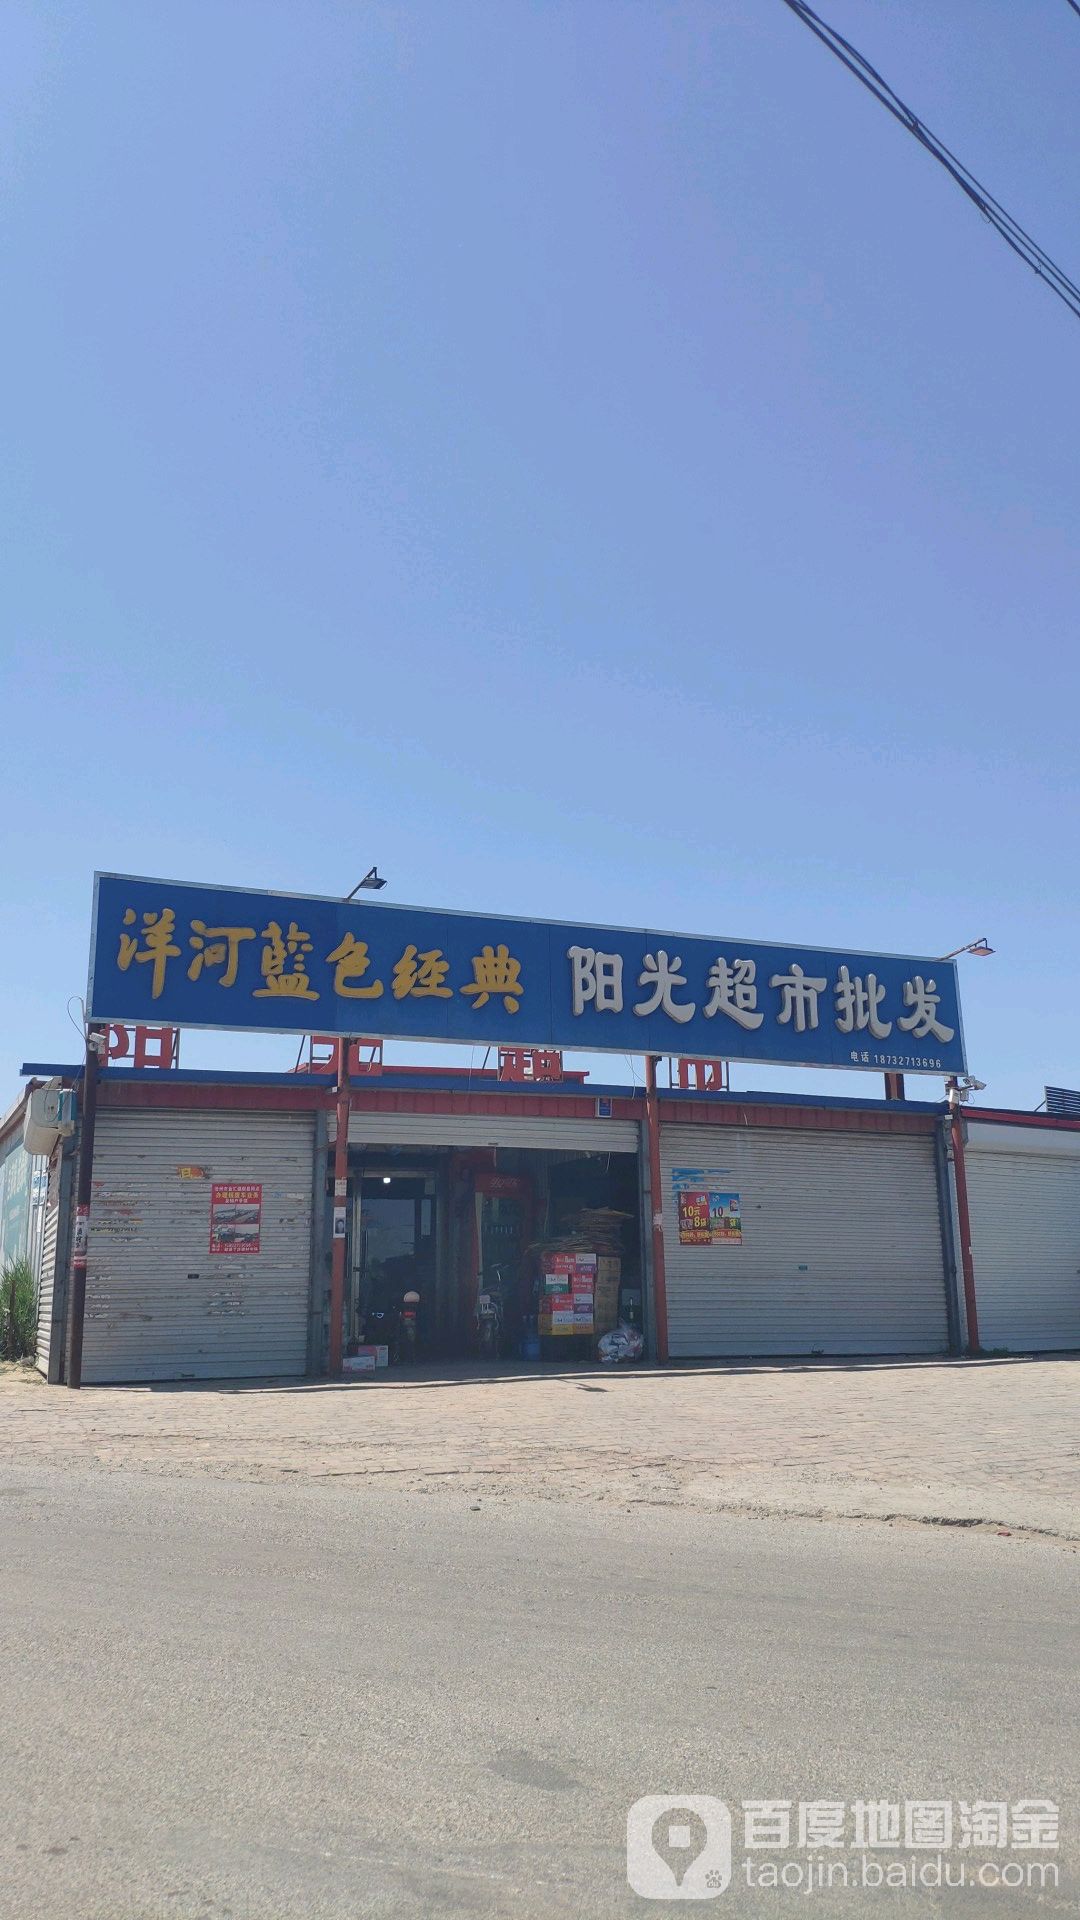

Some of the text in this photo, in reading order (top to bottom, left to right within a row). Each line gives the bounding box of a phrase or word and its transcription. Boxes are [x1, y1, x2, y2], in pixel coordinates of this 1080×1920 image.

[567, 945, 955, 1044] 阳光超市批发
[850, 1051, 942, 1069] 电话 18732713696
